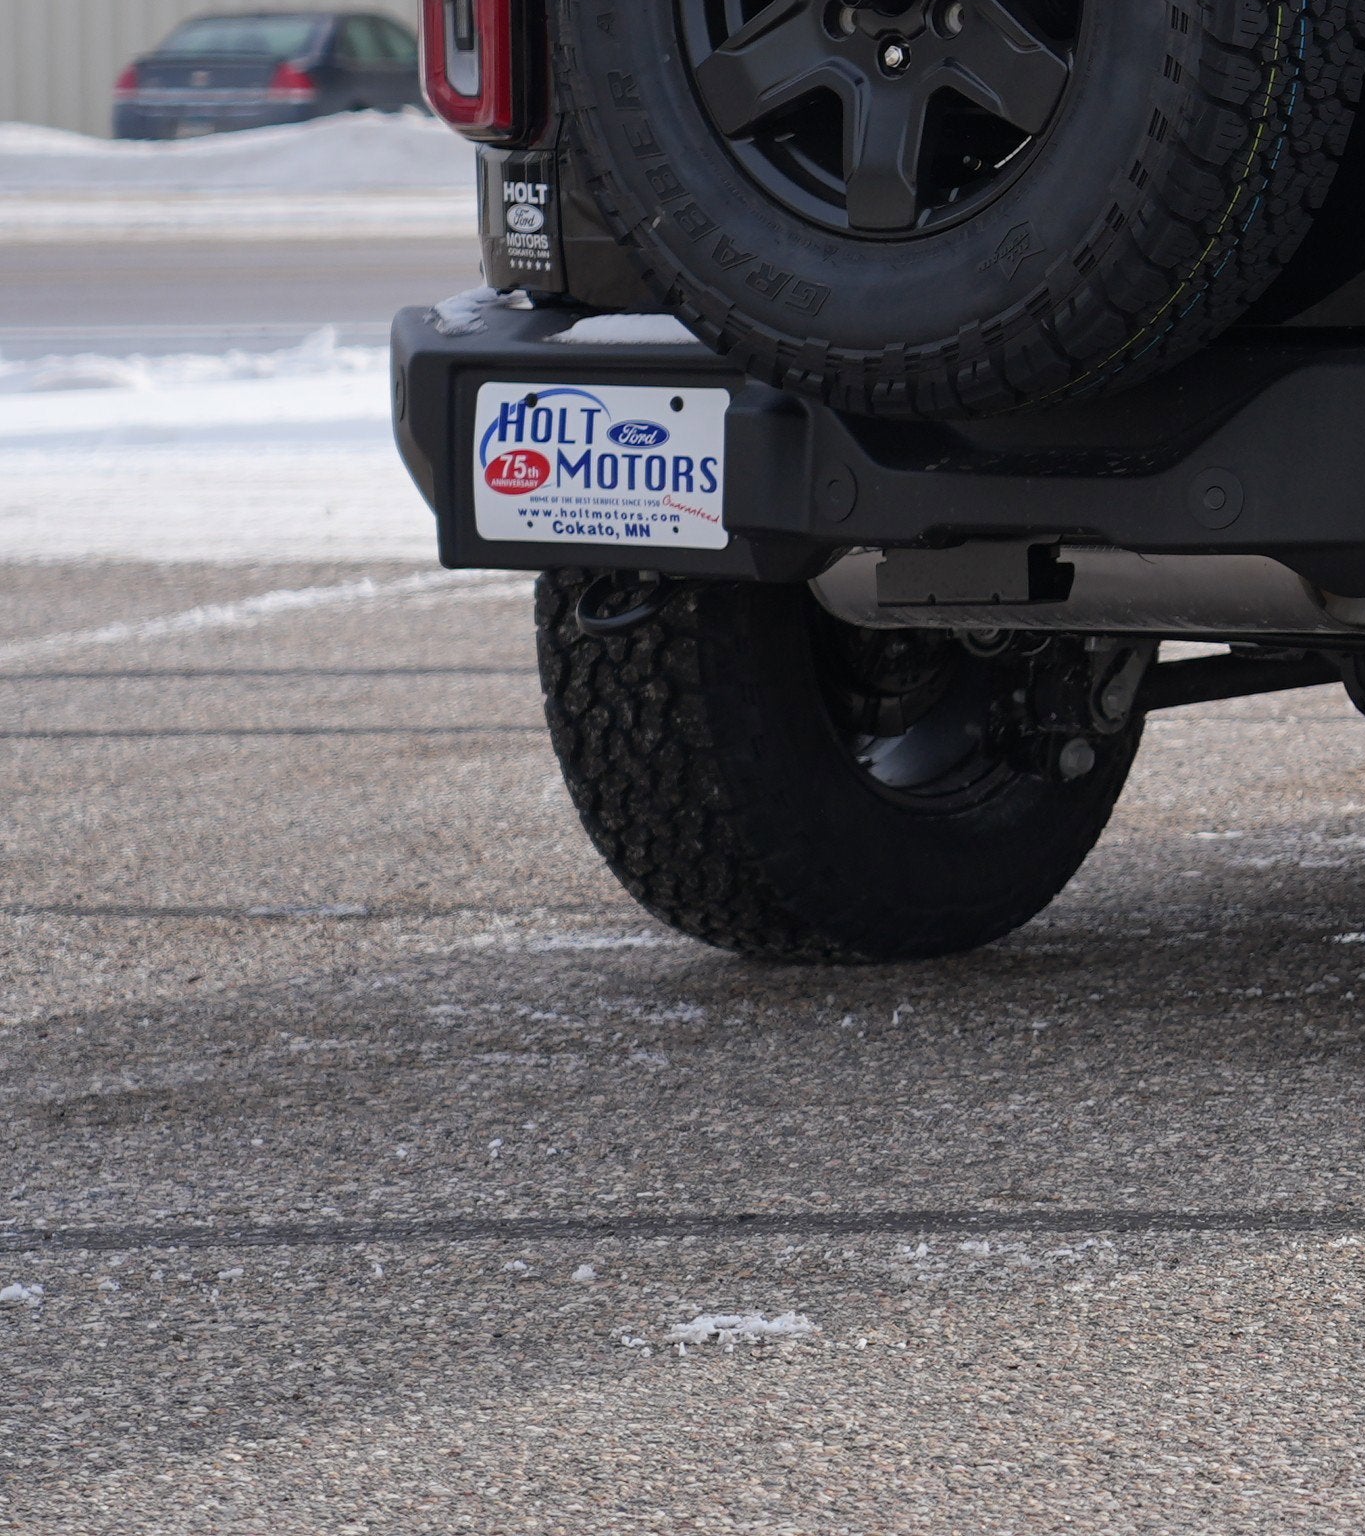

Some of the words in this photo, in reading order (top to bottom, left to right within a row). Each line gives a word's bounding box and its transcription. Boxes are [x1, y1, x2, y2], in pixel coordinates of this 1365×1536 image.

[503, 181, 547, 204] HOLT
[606, 68, 832, 319] GRABBER
[513, 206, 536, 228] Ford
[506, 232, 549, 249] MOTORS
[497, 402, 602, 445] HOLT
[618, 424, 657, 445] Ford
[500, 454, 539, 480] 75th
[556, 448, 719, 494] MOTORS
[491, 478, 539, 488] ANNIVERSARY
[575, 497, 591, 505] BEST
[592, 498, 619, 506] SERVICE
[621, 499, 642, 507] SINCE
[643, 499, 661, 508] 1950
[662, 494, 720, 524] Guaranteed
[517, 507, 681, 523] www.holtmotors.com
[552, 520, 620, 540] Cokato,
[624, 523, 651, 538] MN
